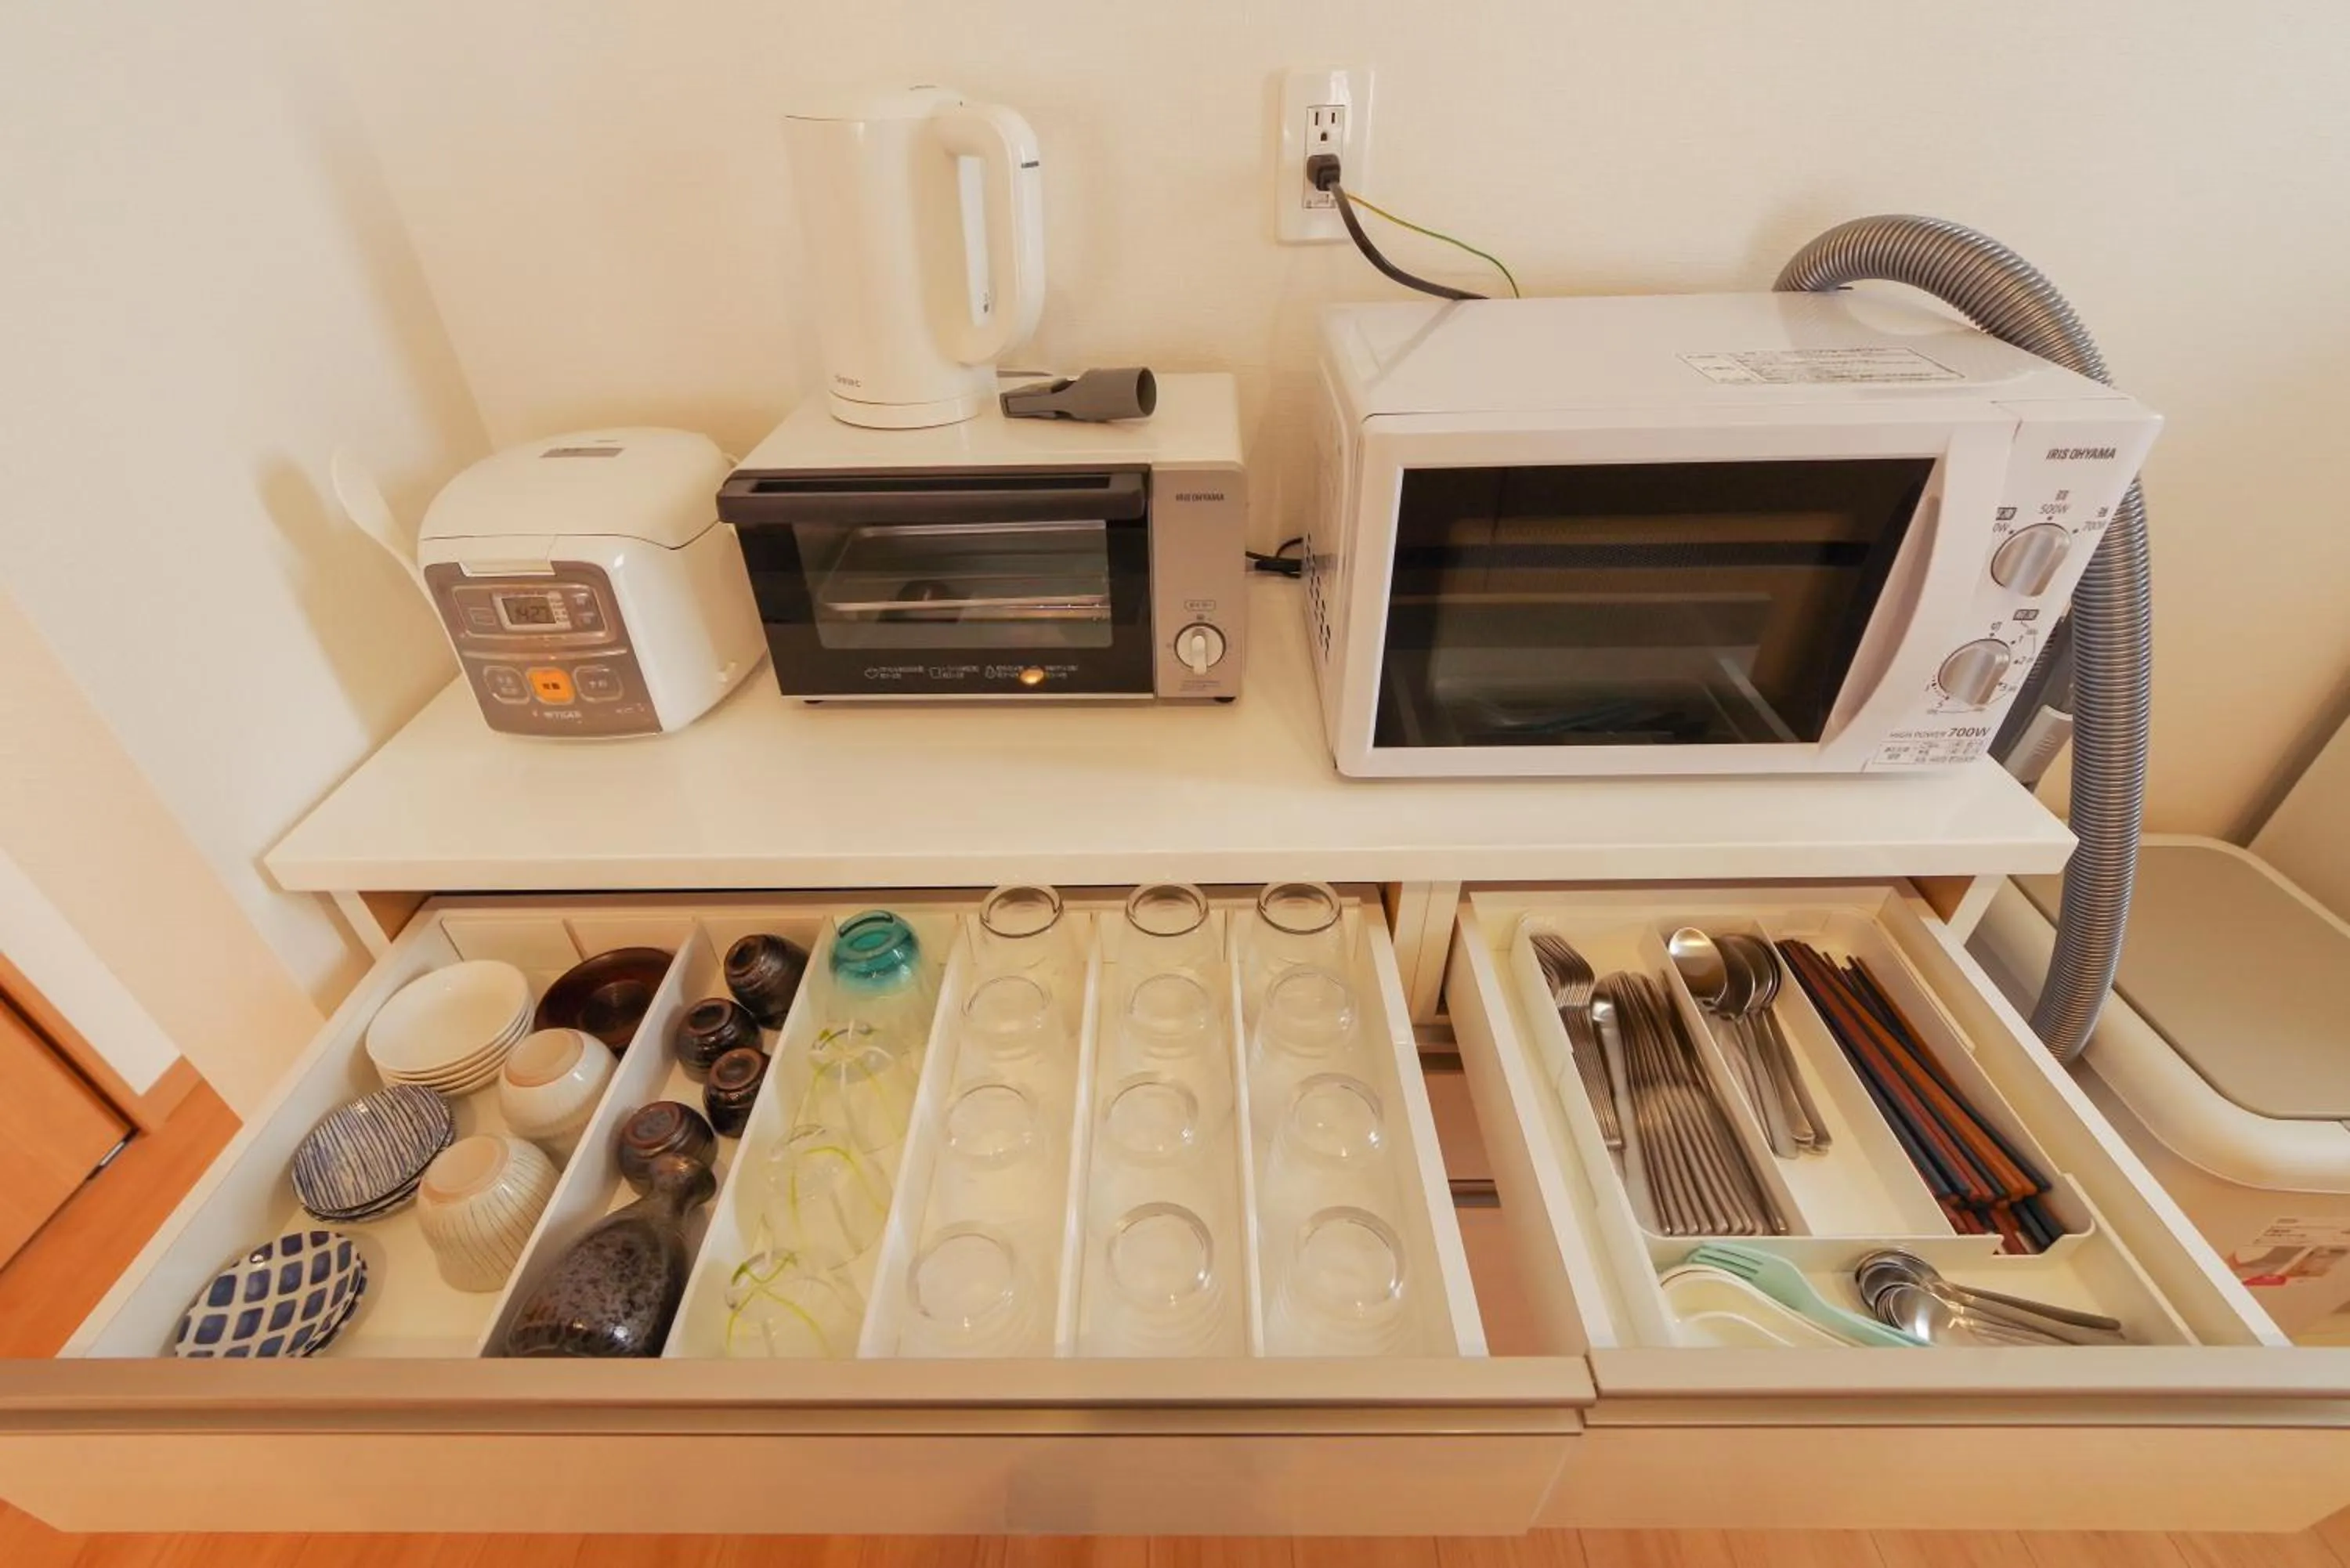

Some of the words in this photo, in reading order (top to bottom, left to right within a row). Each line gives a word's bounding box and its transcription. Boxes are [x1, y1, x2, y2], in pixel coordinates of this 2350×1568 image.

[2045, 448, 2069, 460] IRIS
[2069, 447, 2117, 460] OHYAMA
[2038, 503, 2070, 514] 500W
[1947, 727, 1990, 737] 700W
